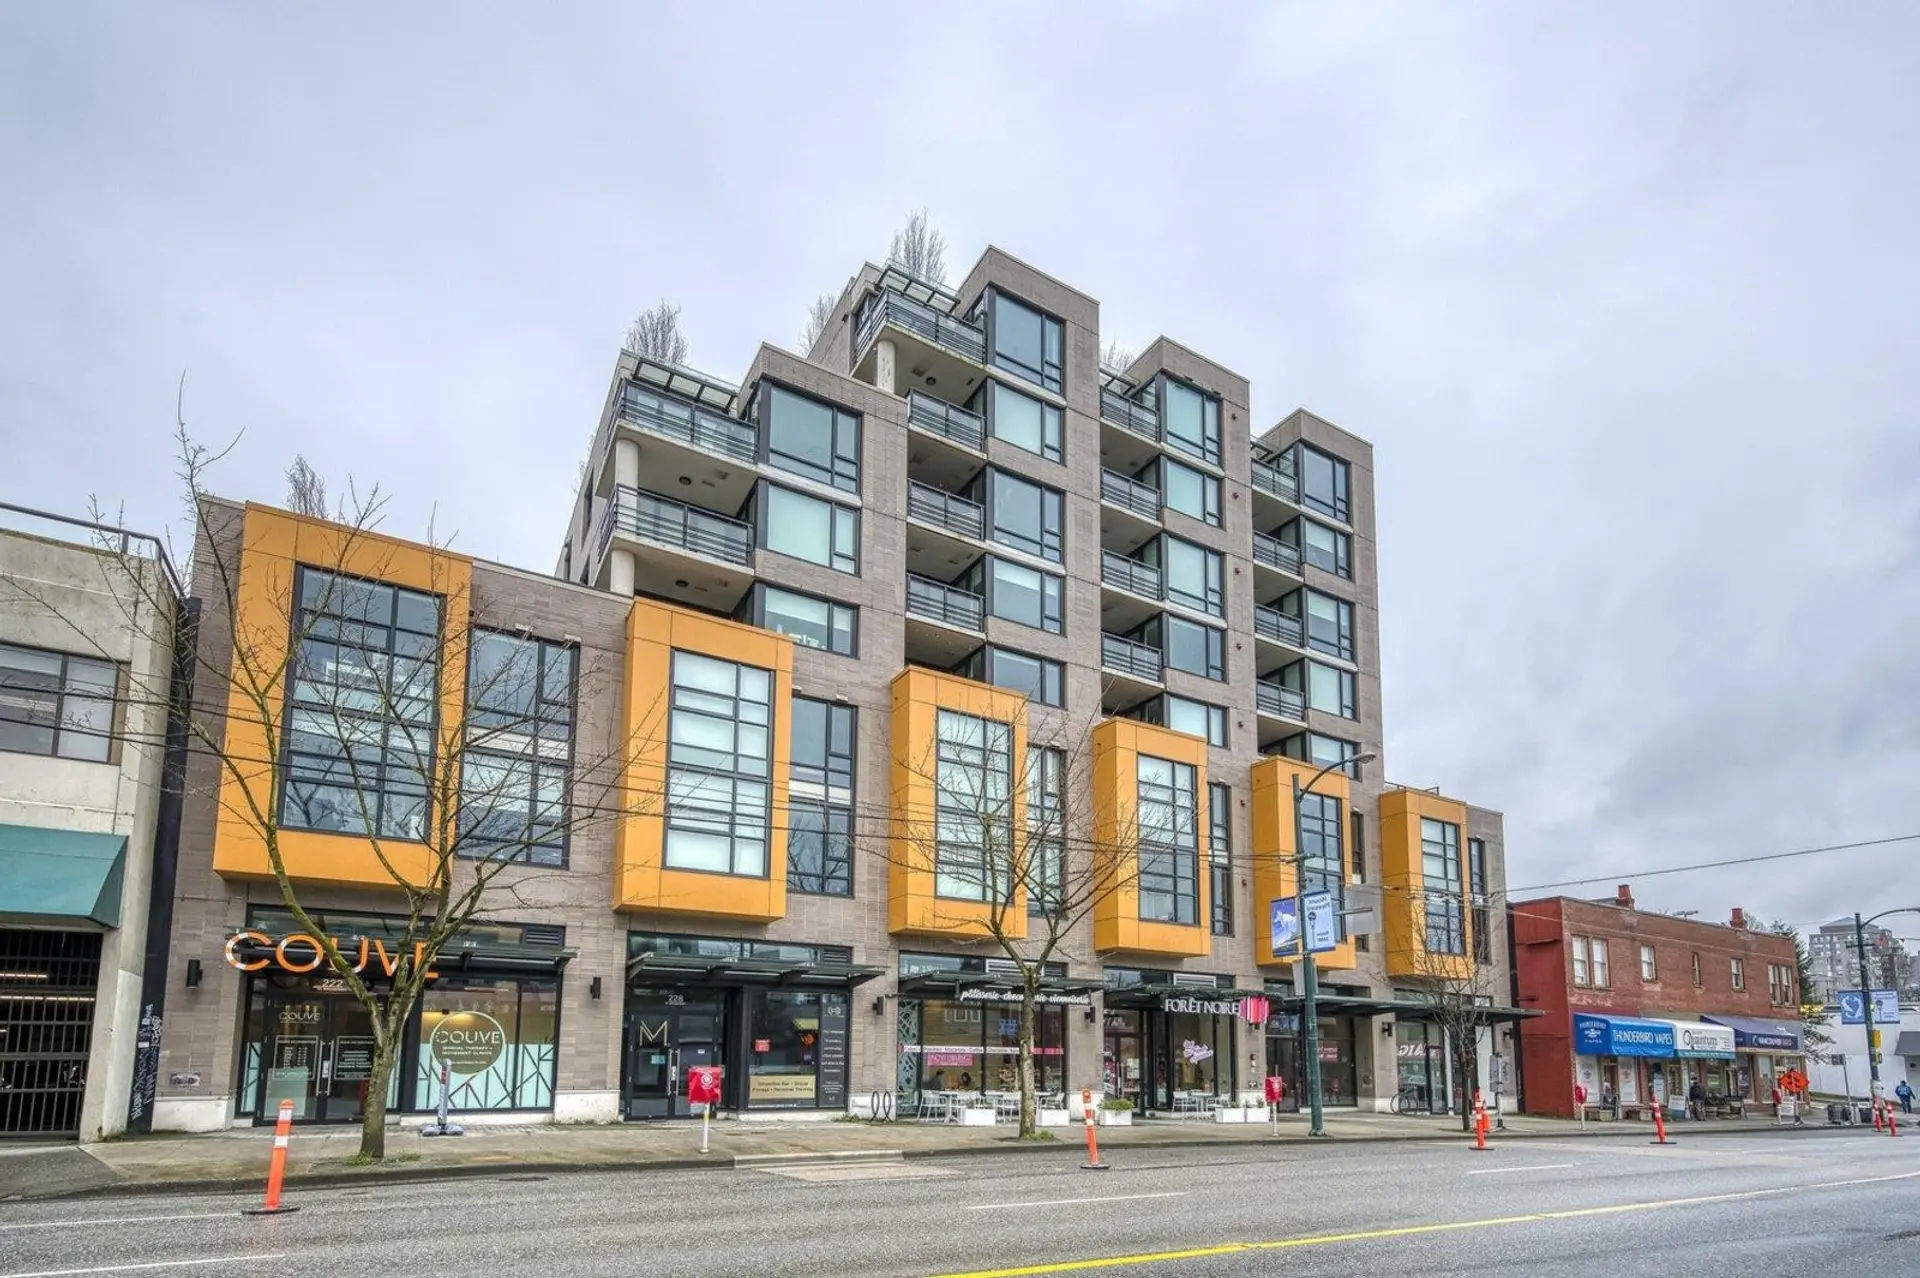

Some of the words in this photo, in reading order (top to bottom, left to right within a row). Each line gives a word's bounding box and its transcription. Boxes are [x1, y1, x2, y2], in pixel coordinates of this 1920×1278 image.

[322, 978, 344, 988] 222
[1165, 997, 1203, 1013] FORÊT
[1203, 1001, 1240, 1016] NOIRE
[279, 1011, 321, 1021] COUVE
[435, 1030, 501, 1044] COUVE
[1613, 1029, 1654, 1043] THUNDERBIRD
[1655, 1033, 1673, 1045] VAPES
